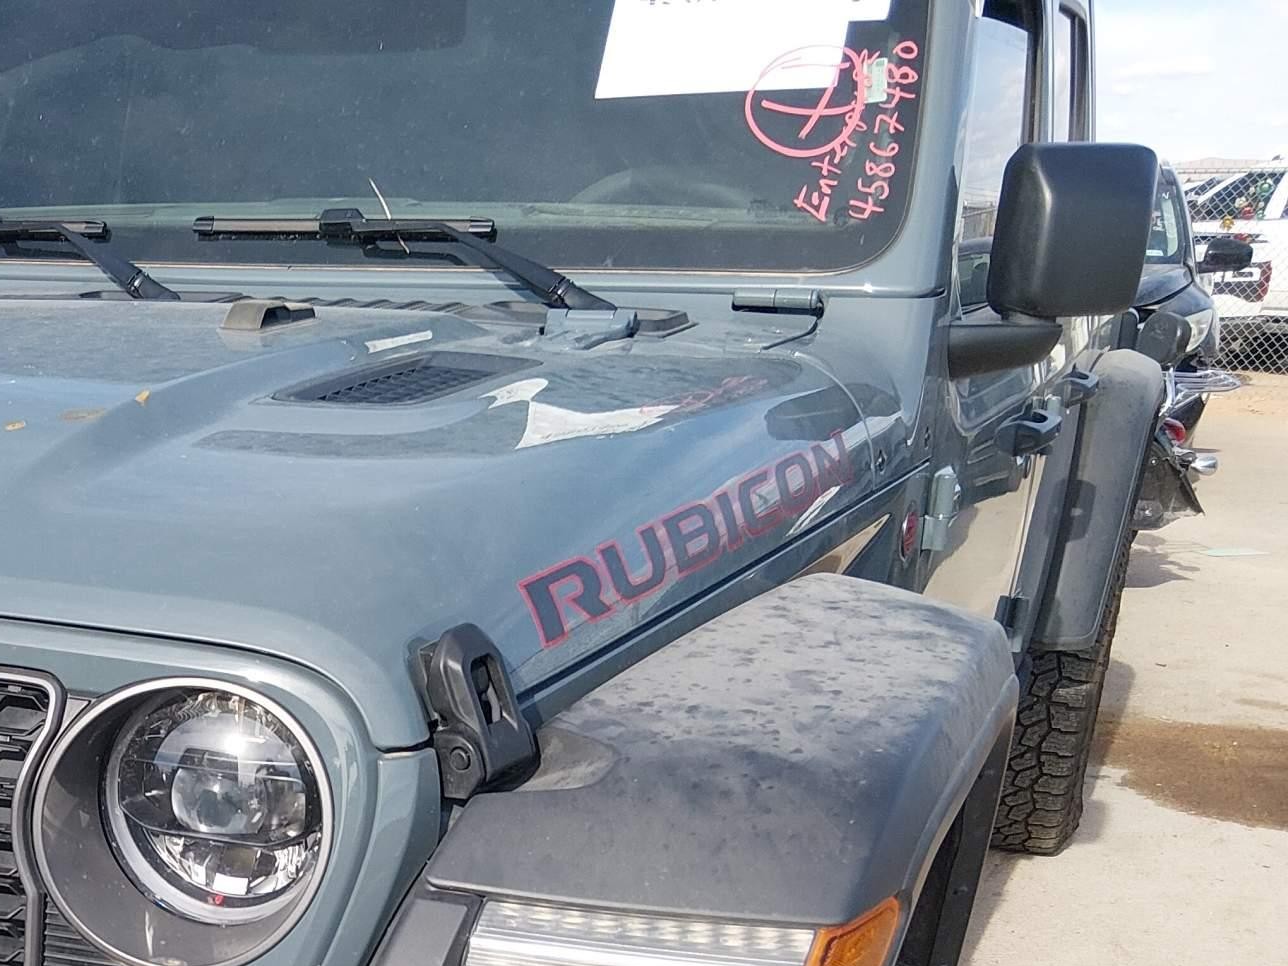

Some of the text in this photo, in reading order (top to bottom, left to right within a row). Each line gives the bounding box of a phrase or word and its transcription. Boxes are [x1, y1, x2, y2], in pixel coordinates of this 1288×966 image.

[793, 48, 881, 222] Enterpse
[848, 40, 919, 219] 45867480
[516, 428, 855, 650] RUBICON
